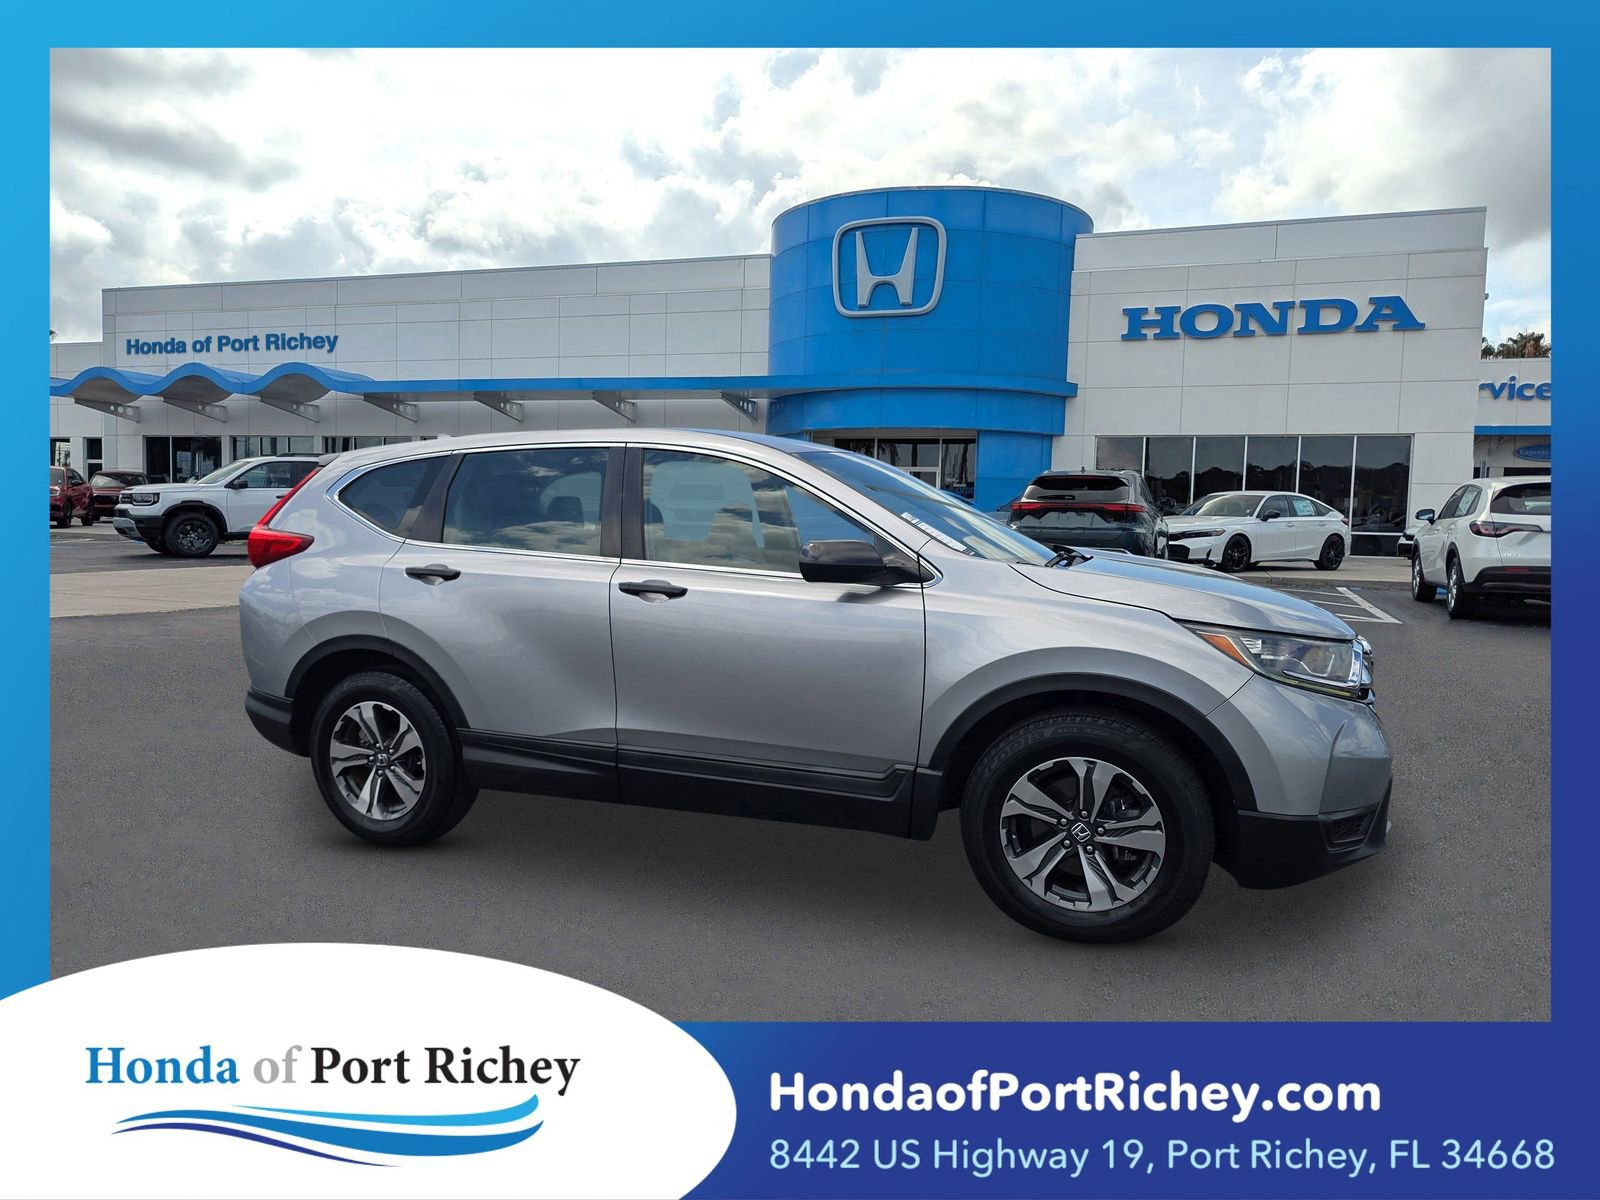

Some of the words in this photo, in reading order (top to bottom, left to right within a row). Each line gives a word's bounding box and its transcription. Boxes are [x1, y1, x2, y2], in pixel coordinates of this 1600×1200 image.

[1120, 295, 1426, 340] HONDA
[126, 337, 187, 355] Honda
[192, 335, 212, 353] of
[217, 335, 259, 352] Port
[265, 332, 339, 353] Richey
